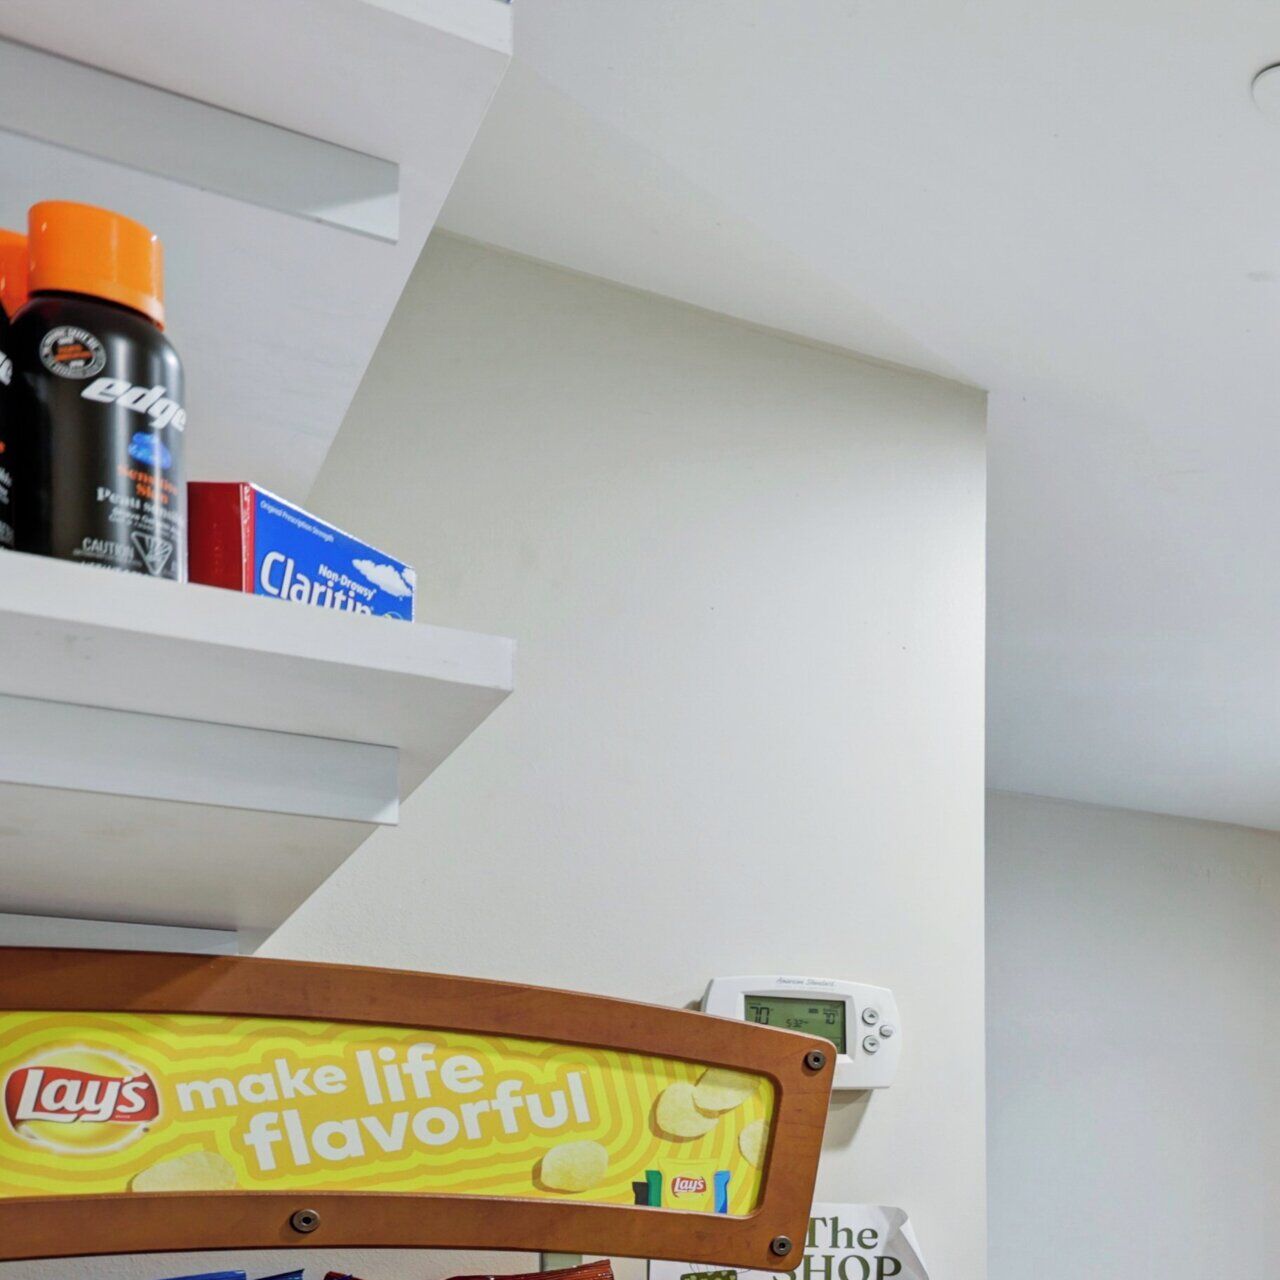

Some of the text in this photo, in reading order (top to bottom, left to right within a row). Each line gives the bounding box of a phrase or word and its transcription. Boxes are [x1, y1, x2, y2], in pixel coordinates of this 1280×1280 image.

[81, 377, 187, 432] edge
[319, 563, 375, 601] Non-Drowsy
[16, 1068, 151, 1123] Lay's
[175, 1042, 485, 1112] make life
[243, 1071, 592, 1171] flavorful
[673, 1176, 706, 1196] Lay's
[805, 1216, 879, 1250] The
